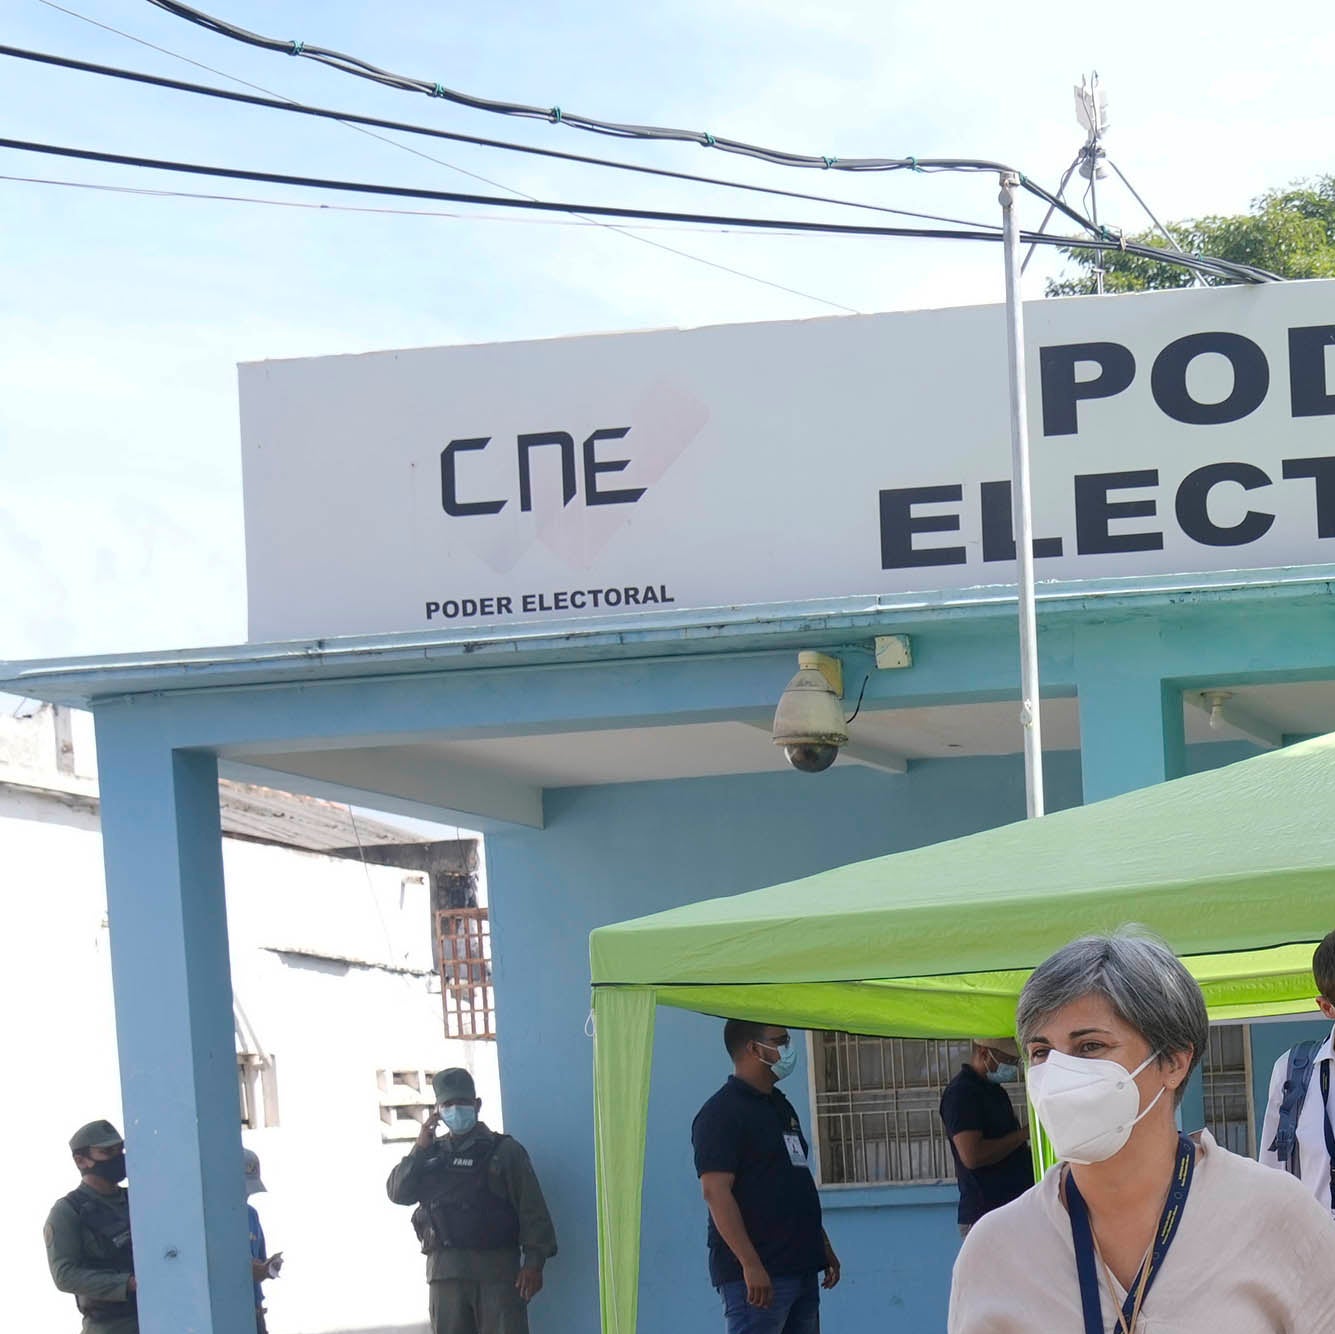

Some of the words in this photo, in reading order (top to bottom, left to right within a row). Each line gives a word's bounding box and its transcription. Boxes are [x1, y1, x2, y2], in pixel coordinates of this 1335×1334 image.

[441, 427, 647, 516] CNE
[425, 597, 513, 620] PODER
[521, 584, 675, 612] ELECTORAL
